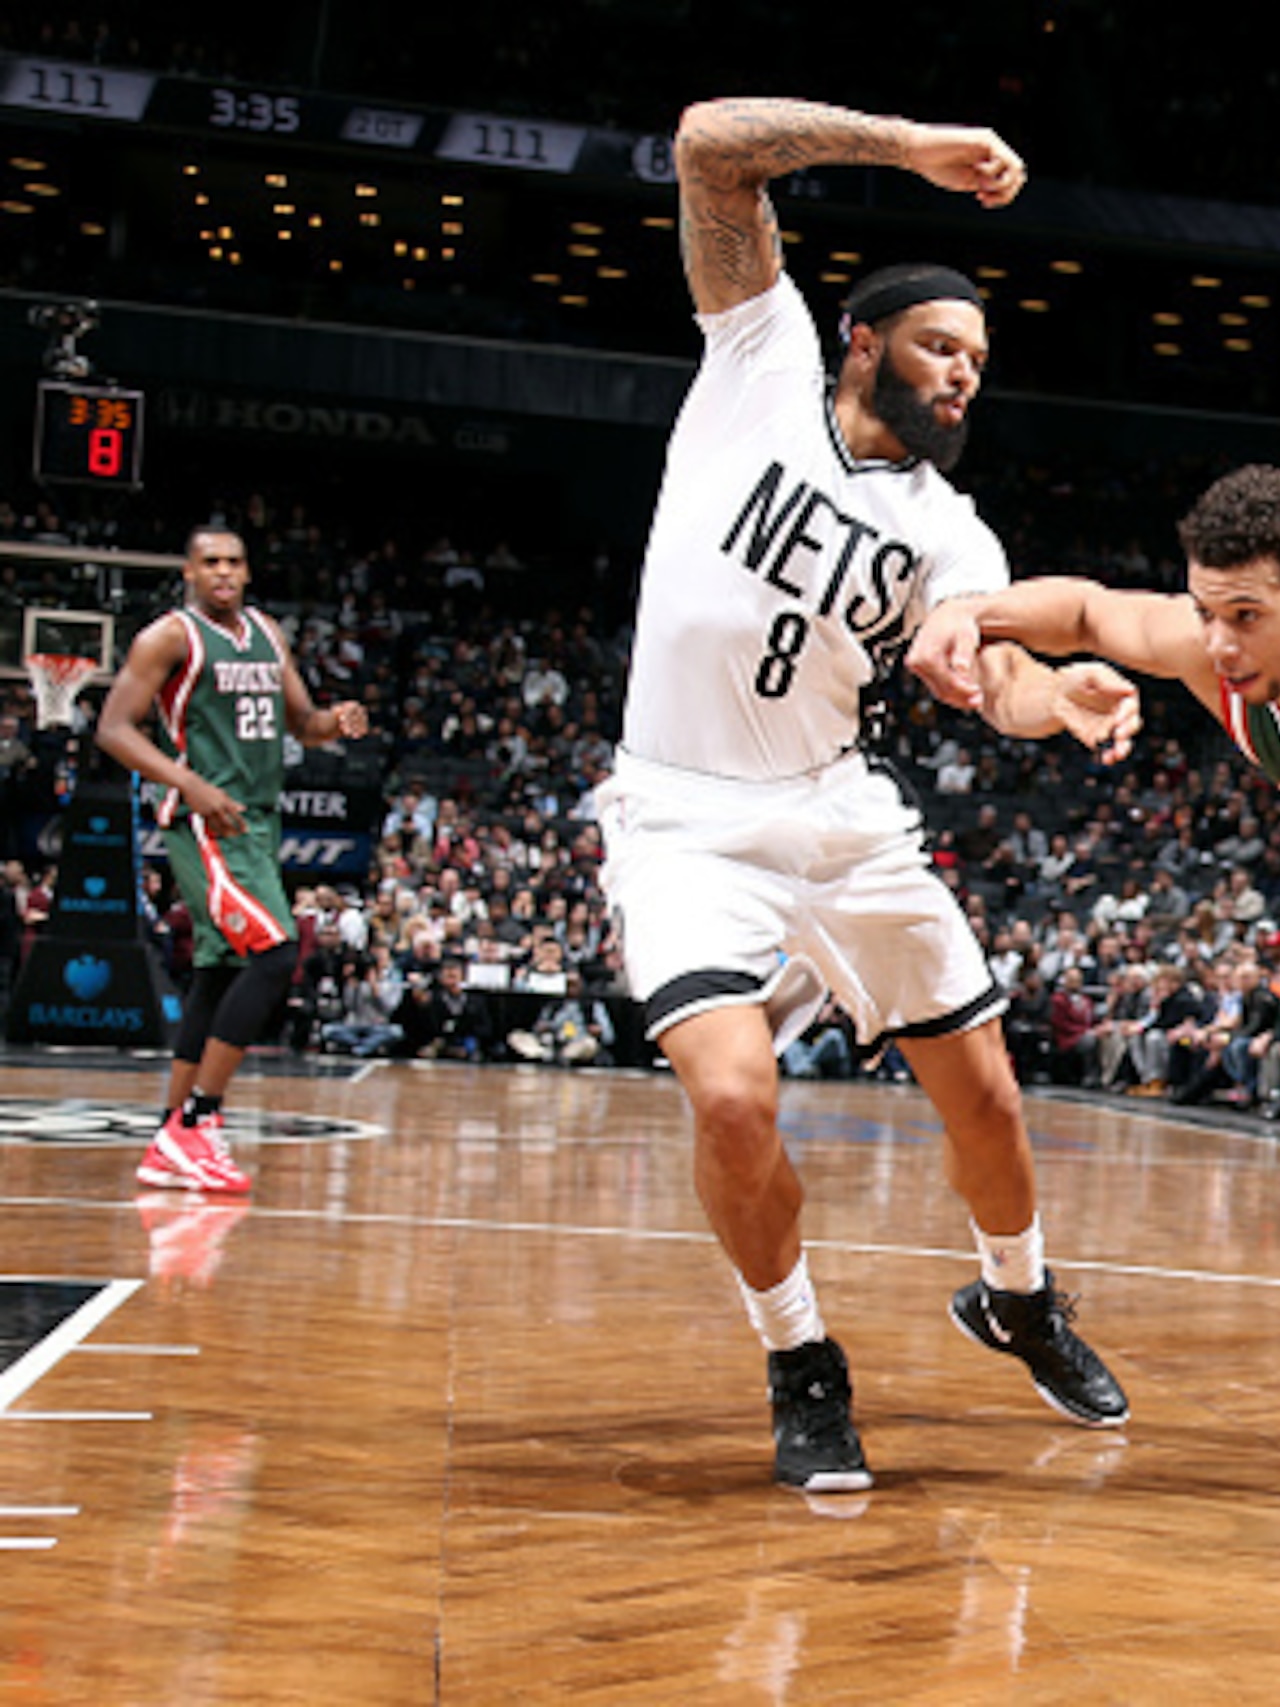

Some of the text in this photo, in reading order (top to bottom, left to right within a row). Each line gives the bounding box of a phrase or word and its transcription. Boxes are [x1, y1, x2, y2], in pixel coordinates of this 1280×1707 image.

[27, 66, 110, 109] 111
[208, 88, 301, 132] 3:35
[474, 123, 550, 163] 111
[216, 397, 437, 447] HONDA
[88, 428, 123, 477] 8
[719, 460, 915, 632] NETS
[755, 612, 809, 698] 8
[235, 696, 277, 740] 22
[276, 790, 348, 821] NTER
[28, 1003, 146, 1032] BARCLAYS
